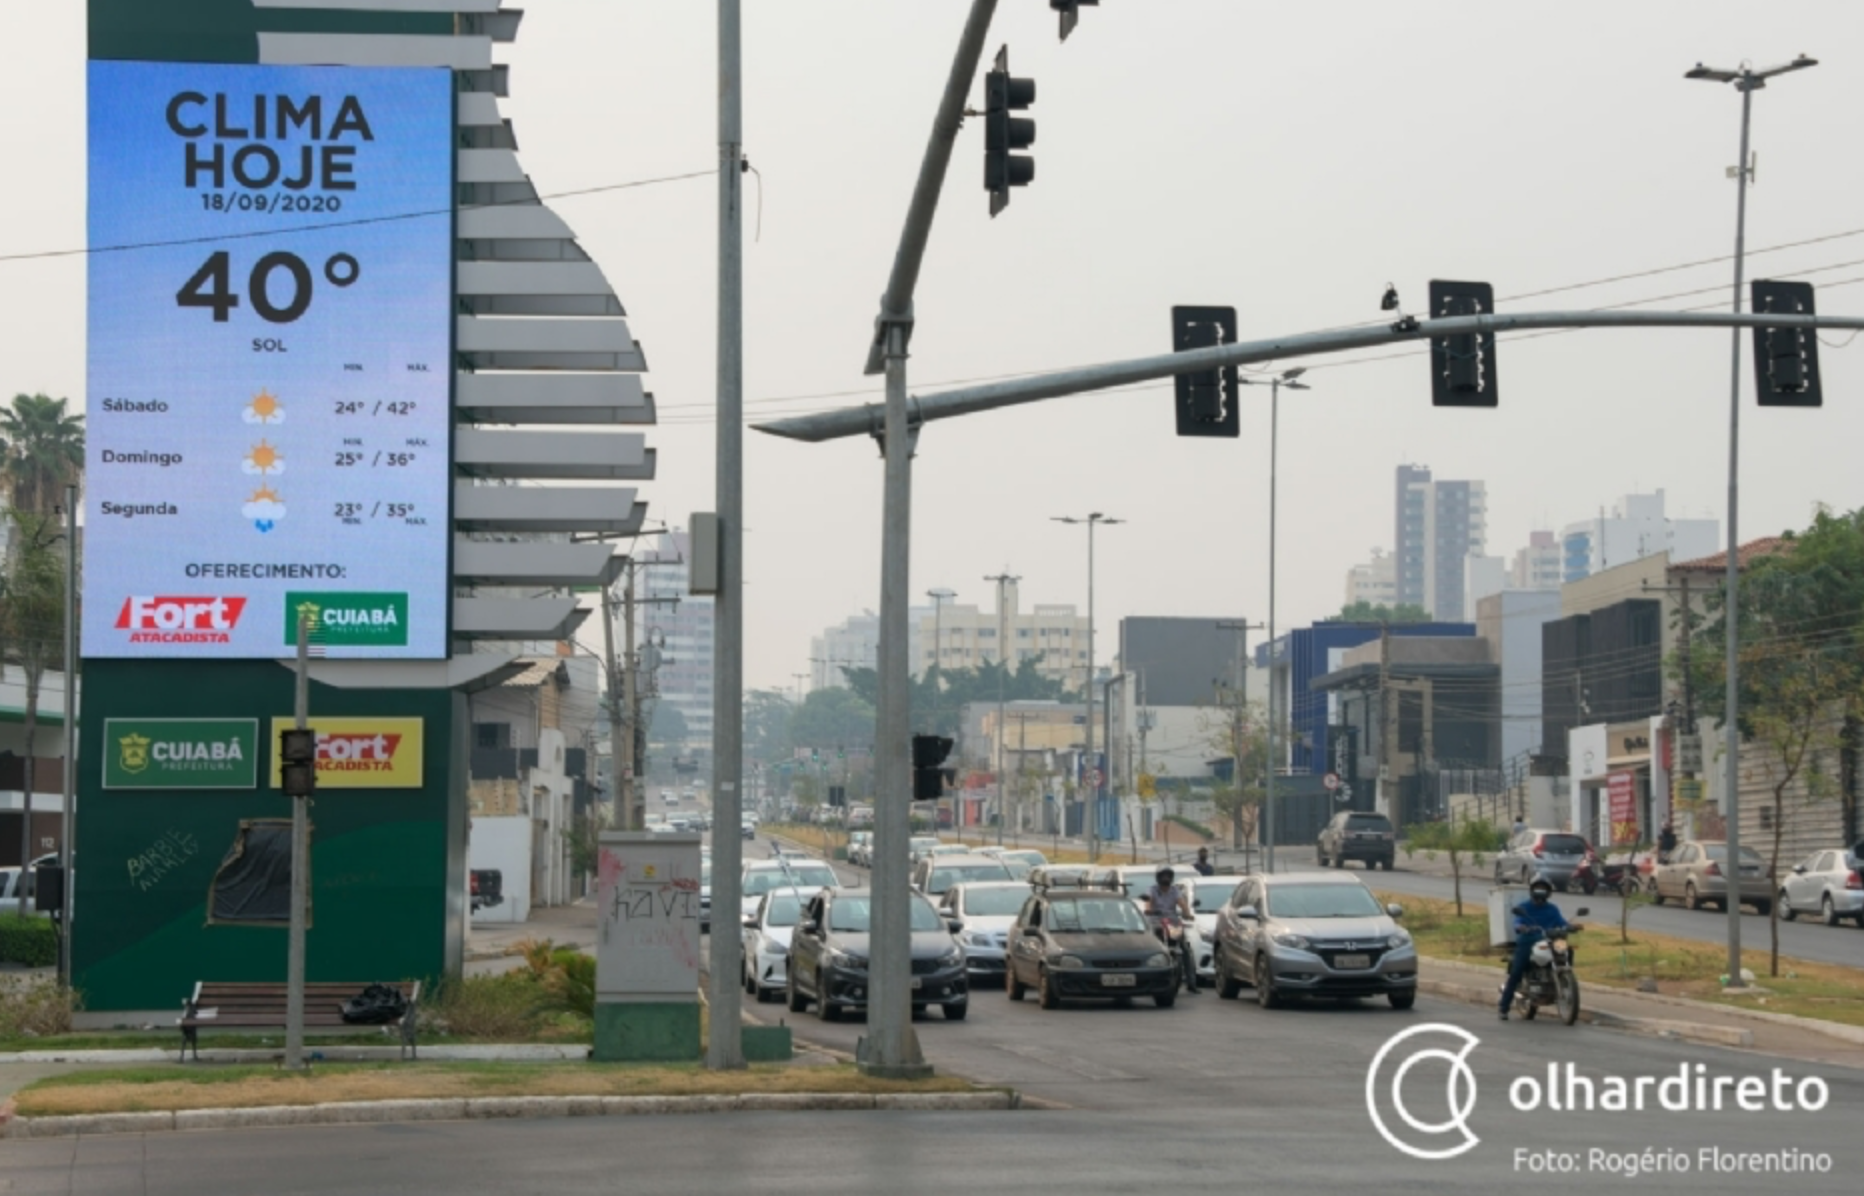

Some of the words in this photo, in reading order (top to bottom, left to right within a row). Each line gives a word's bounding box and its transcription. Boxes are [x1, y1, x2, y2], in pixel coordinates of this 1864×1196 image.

[165, 90, 375, 142] CLIMA
[184, 142, 357, 190] HOJE
[201, 192, 341, 213] 18/09/2020
[175, 250, 360, 323] 40°
[252, 338, 287, 352] SOL
[102, 397, 169, 413] Sábado
[102, 450, 183, 468] Domingo
[101, 501, 178, 520] Segunda
[185, 563, 347, 579] OFERECIMENTO:
[129, 595, 231, 629] Fort
[323, 604, 398, 626] CUIABÁ
[129, 631, 230, 643] ATACADISTA
[152, 736, 243, 761] CUIABÁ
[314, 733, 389, 760] Fort
[161, 761, 234, 771] PREFEITURA
[314, 761, 393, 771] ACADISTA
